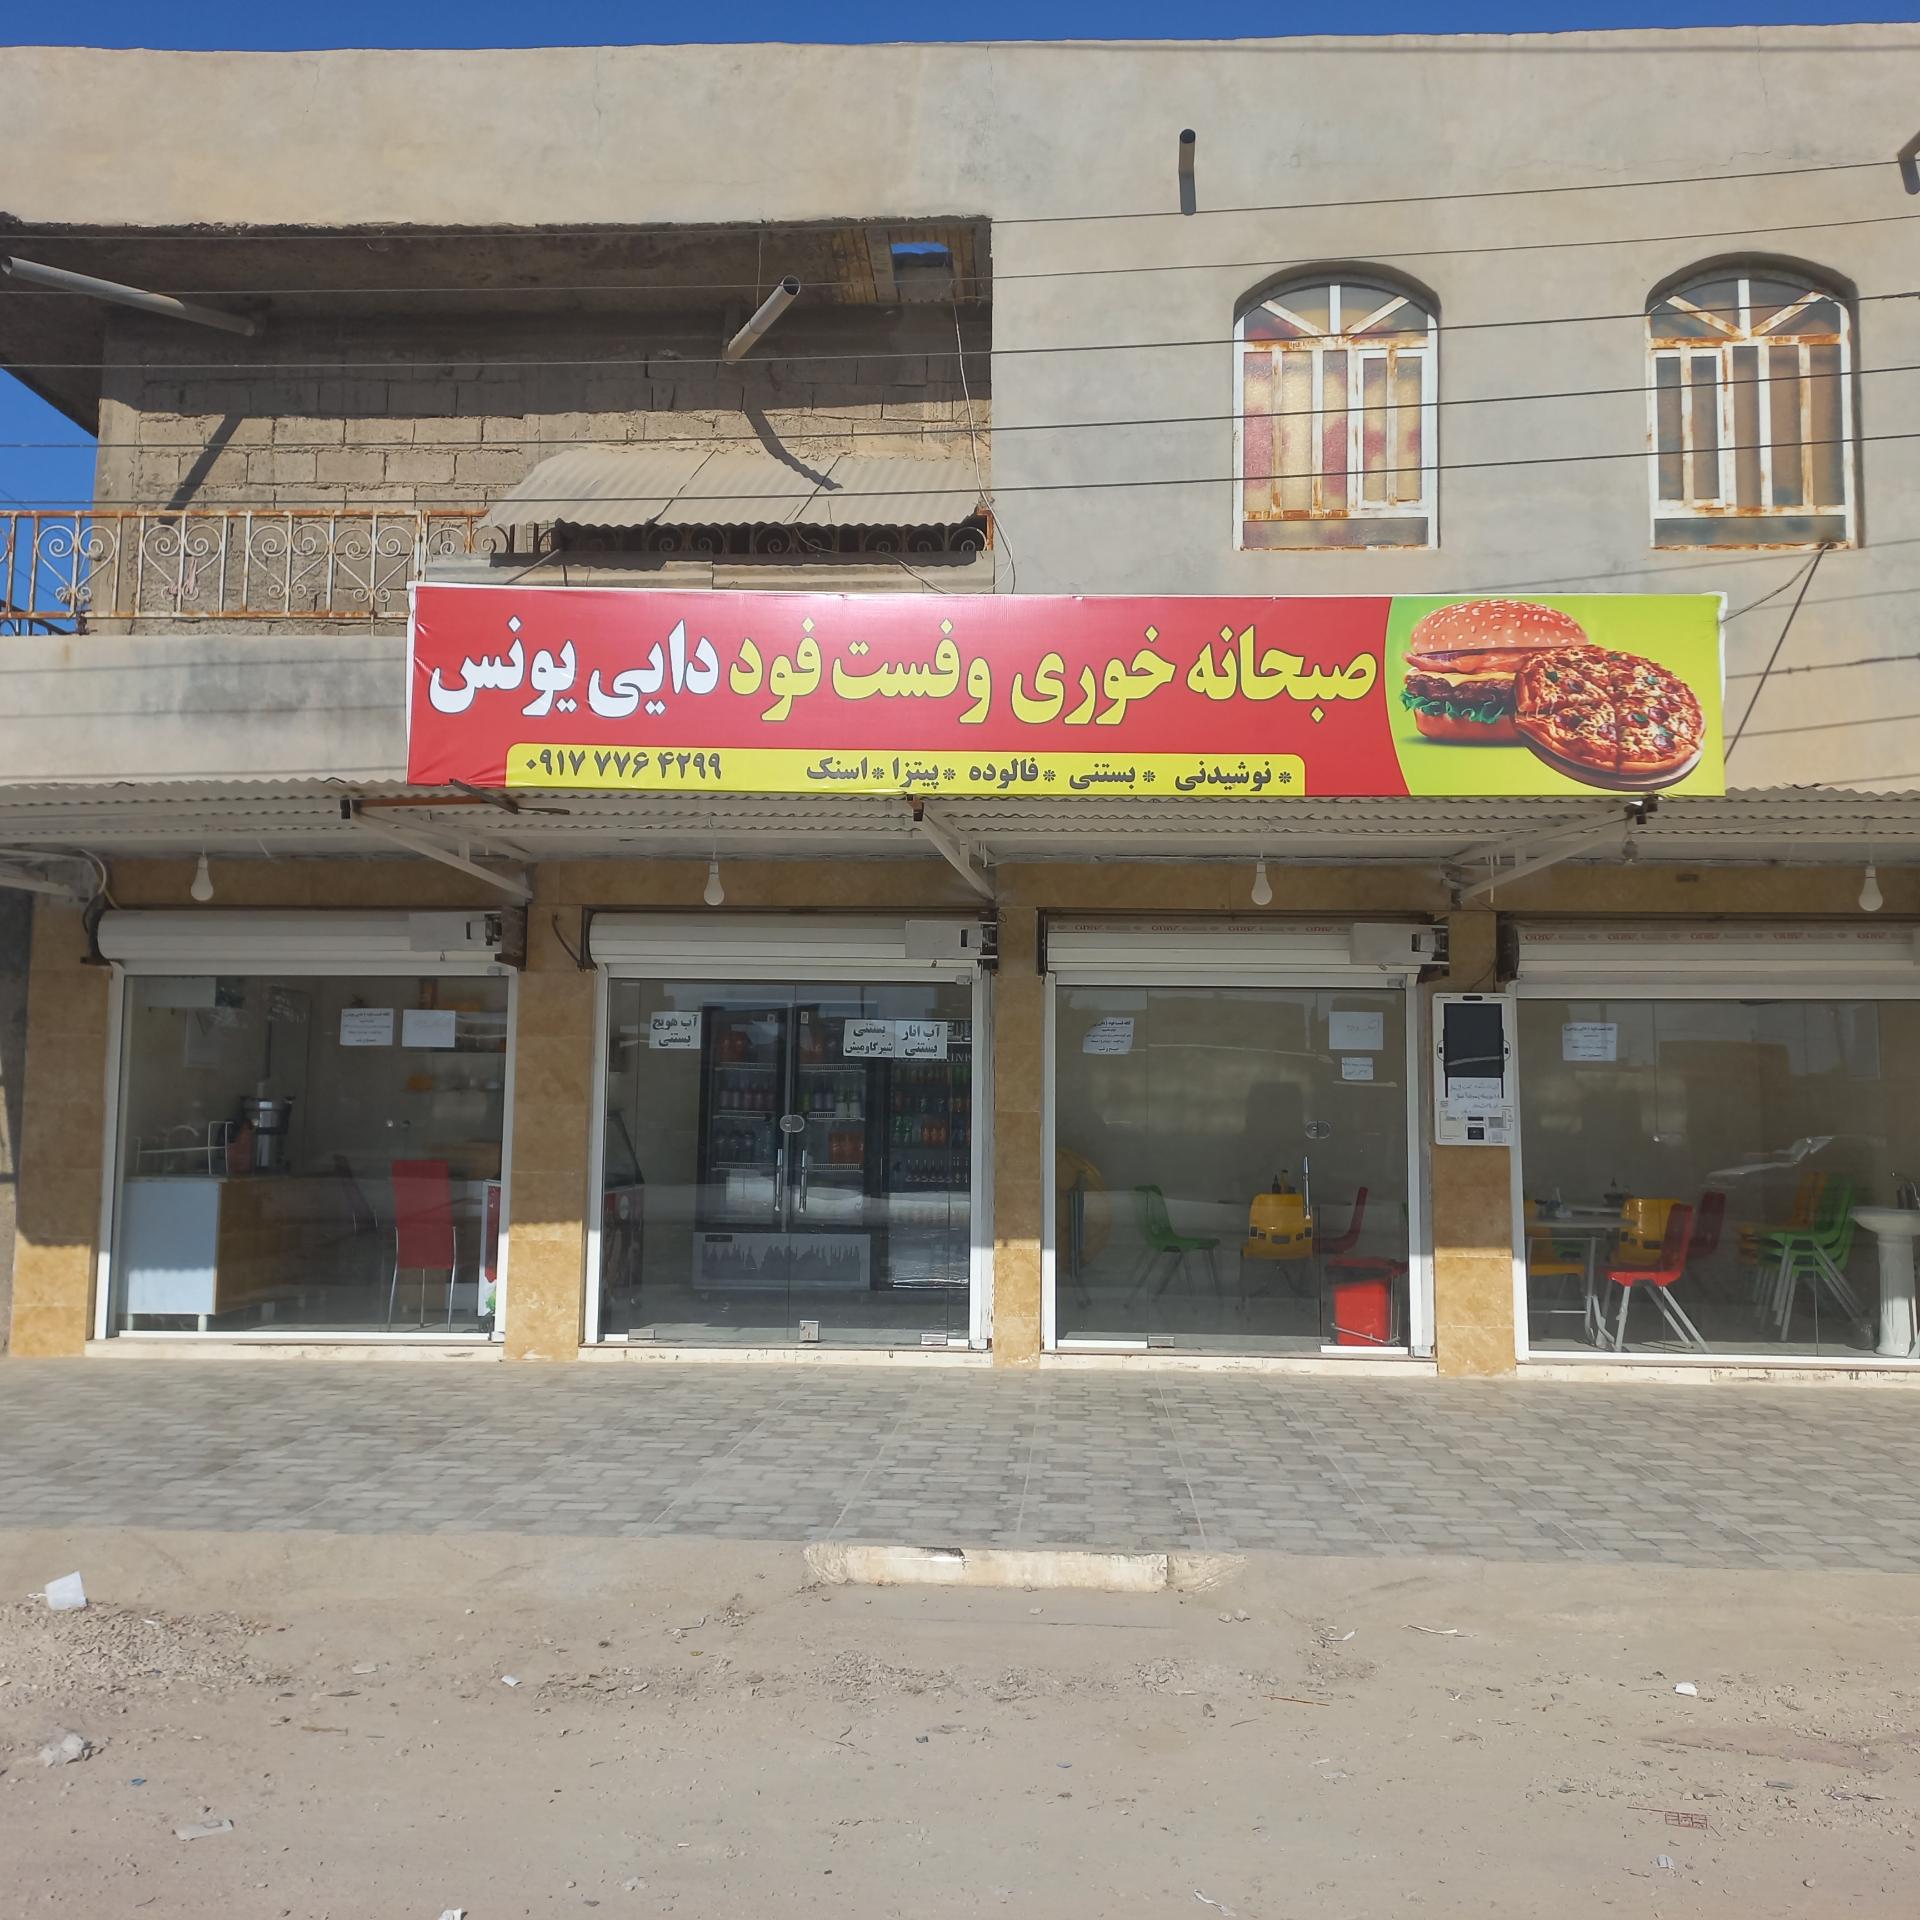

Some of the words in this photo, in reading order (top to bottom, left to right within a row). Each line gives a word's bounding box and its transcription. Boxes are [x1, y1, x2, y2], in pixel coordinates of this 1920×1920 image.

[429, 615, 579, 717] یونس
[588, 618, 720, 718] دایی
[729, 617, 822, 722] فود
[1011, 624, 1176, 725] خوری
[1187, 624, 1378, 723] صبحانه
[806, 756, 868, 780] اسنک
[892, 756, 940, 789] پیتزا
[968, 757, 1039, 789] فالوده
[1068, 763, 1136, 790] بستنی
[1174, 760, 1272, 792] نوشیدنی
[681, 1014, 698, 1030] آب
[853, 1023, 886, 1037] بستنی
[901, 1024, 920, 1041] انار
[923, 1024, 940, 1041] آب
[658, 1032, 691, 1047] بستنی
[904, 1042, 938, 1056] بستنی
